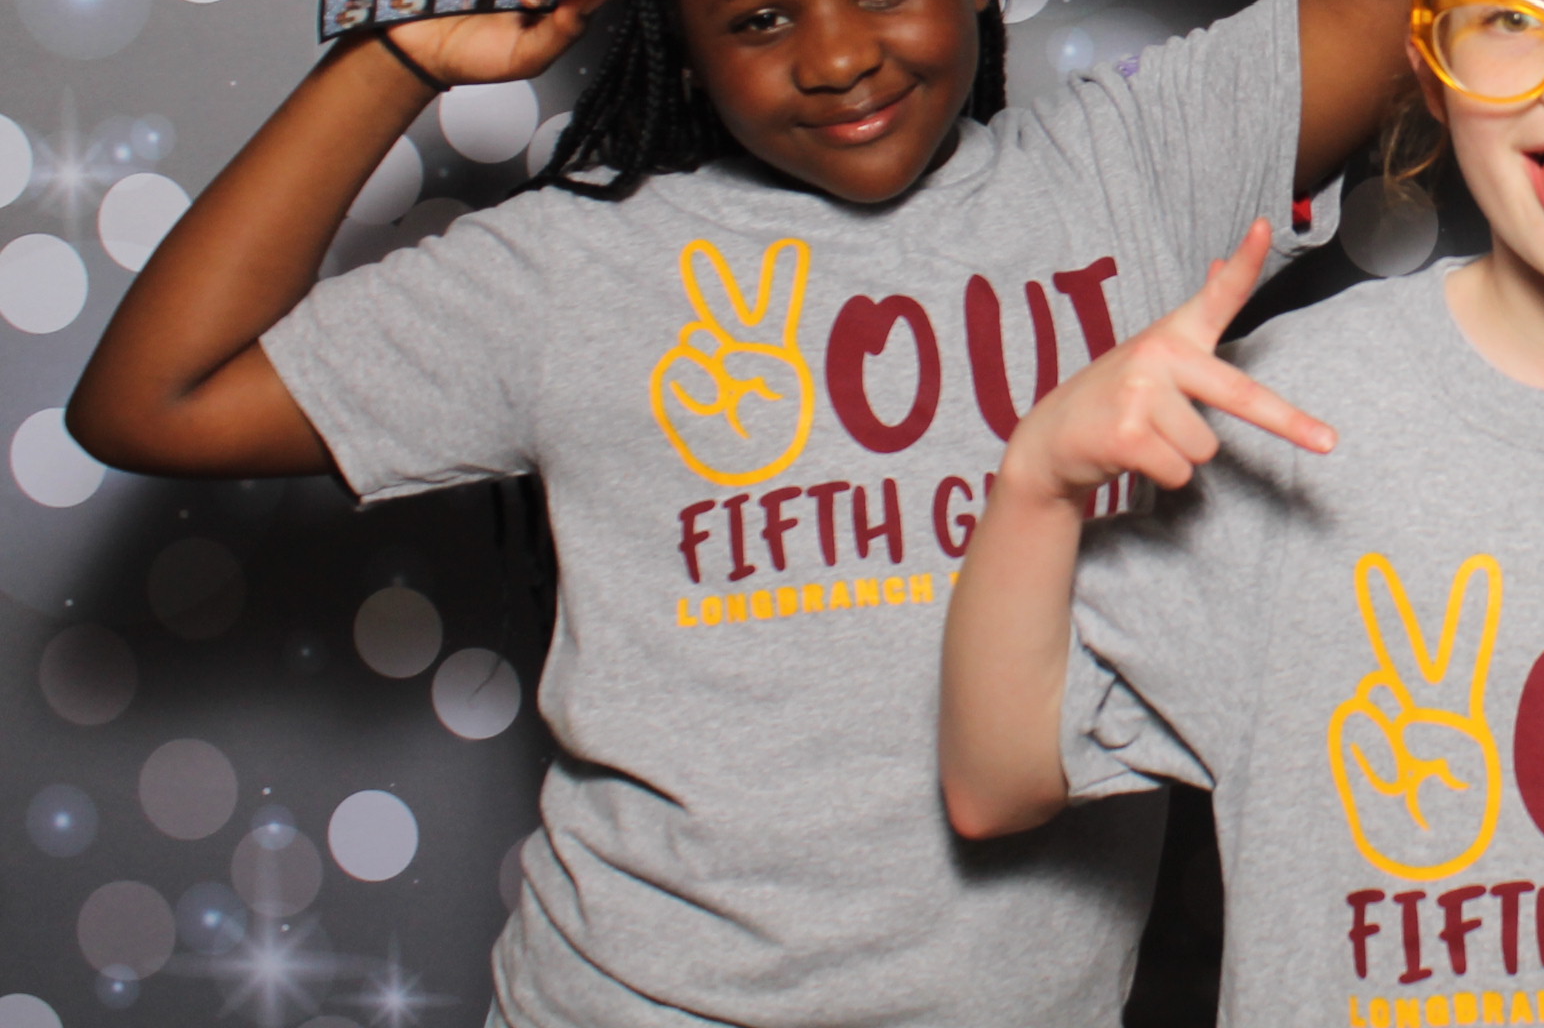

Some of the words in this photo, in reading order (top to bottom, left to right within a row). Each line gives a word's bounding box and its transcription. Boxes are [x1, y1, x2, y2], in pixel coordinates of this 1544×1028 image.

[826, 256, 1119, 455] OUT
[678, 478, 903, 584] FIFTH
[677, 573, 935, 627] LONGBRANCH
